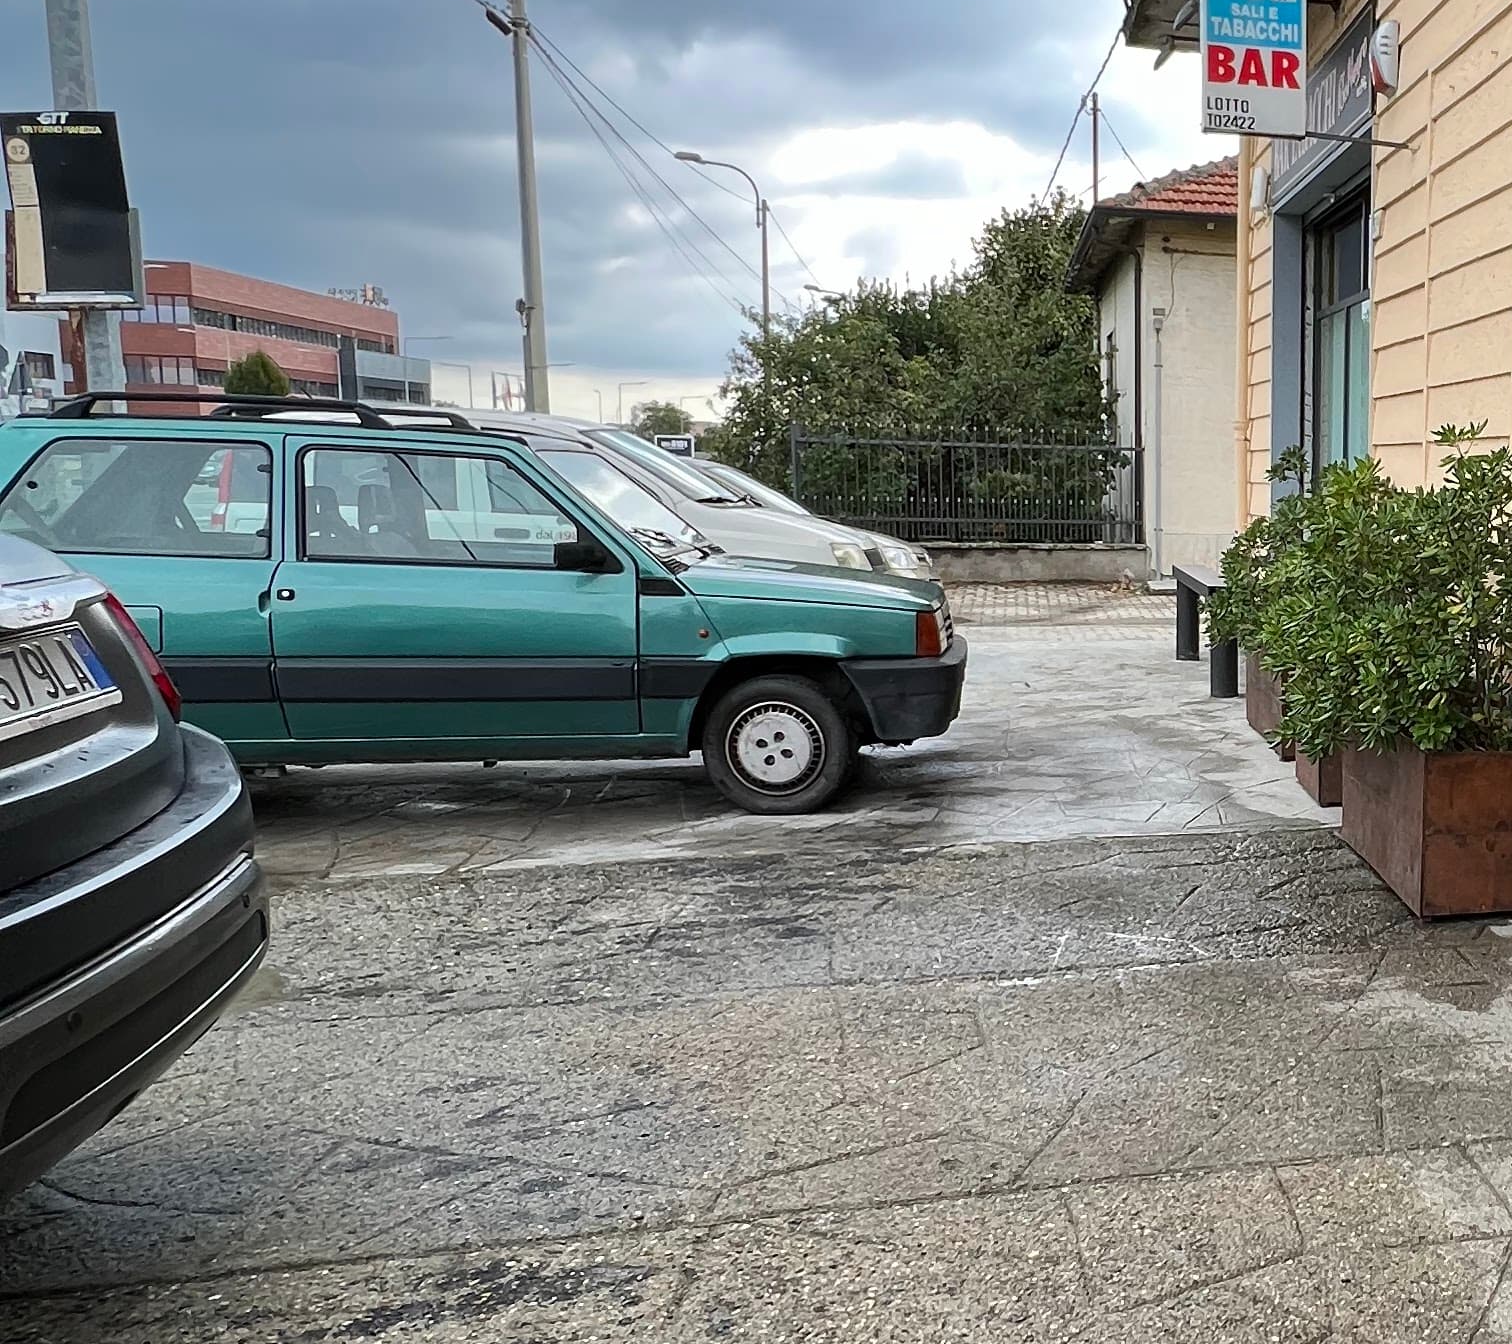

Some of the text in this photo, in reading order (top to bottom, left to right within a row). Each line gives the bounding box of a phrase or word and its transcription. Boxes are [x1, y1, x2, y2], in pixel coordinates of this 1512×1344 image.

[1231, 2, 1279, 21] SALI E
[1210, 16, 1299, 44] TABACCHI
[1207, 44, 1301, 90] BAR
[1207, 95, 1249, 114] LOTTO
[37, 112, 69, 124] GTT
